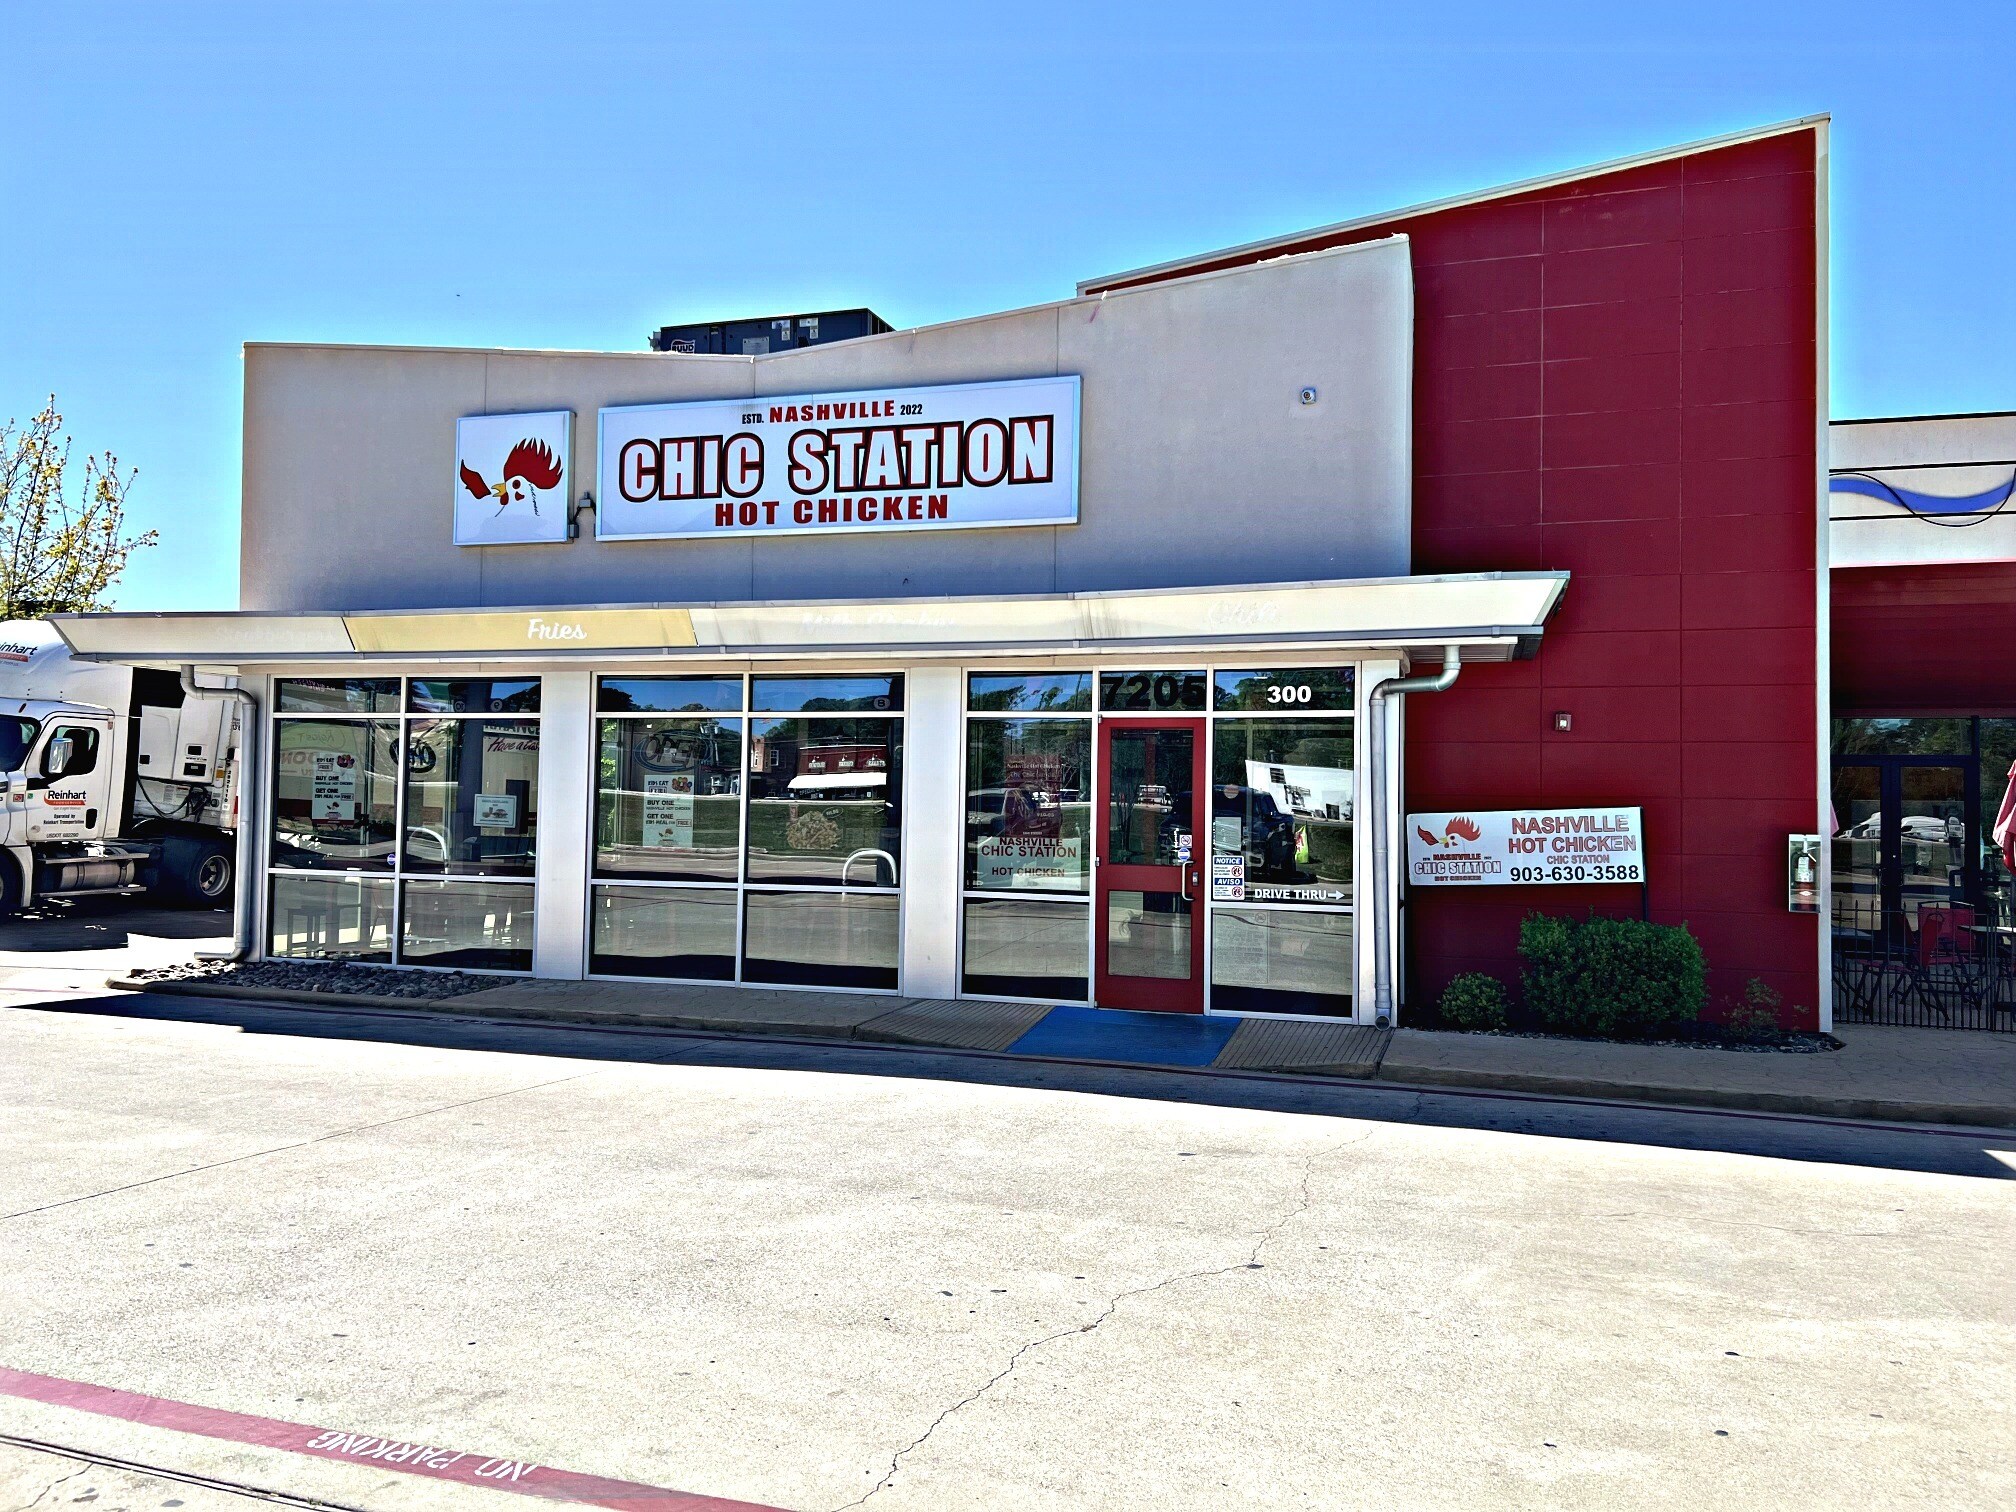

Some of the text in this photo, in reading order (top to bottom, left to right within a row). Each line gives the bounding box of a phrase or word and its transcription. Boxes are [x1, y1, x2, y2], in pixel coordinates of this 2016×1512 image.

[741, 400, 923, 425] ESTD. NASHVILLE 2022
[619, 431, 765, 502] CHIC
[788, 414, 1055, 494] STATION
[714, 495, 949, 527] HOT CHICKEN
[527, 617, 588, 643] Fries
[0, 641, 38, 656] inhart
[1099, 675, 1206, 708] 7205
[1266, 685, 1312, 704] 300
[487, 737, 515, 752] Have
[47, 789, 87, 800] Reinhart
[1511, 815, 1629, 835] NASHVILLE
[999, 837, 1063, 847] NASHVILLE
[1508, 835, 1637, 854] HOT CHICKEN
[981, 845, 1077, 858] CHIC STATION
[1547, 854, 1610, 865] CHIC STATION
[991, 866, 1065, 878] HOT CHICKEN
[1414, 861, 1502, 875] CHIC STATION
[1510, 865, 1640, 882] 903-630-3588
[1254, 888, 1327, 900] DRIVE THRU
[306, 1431, 539, 1481] NO PARKING
